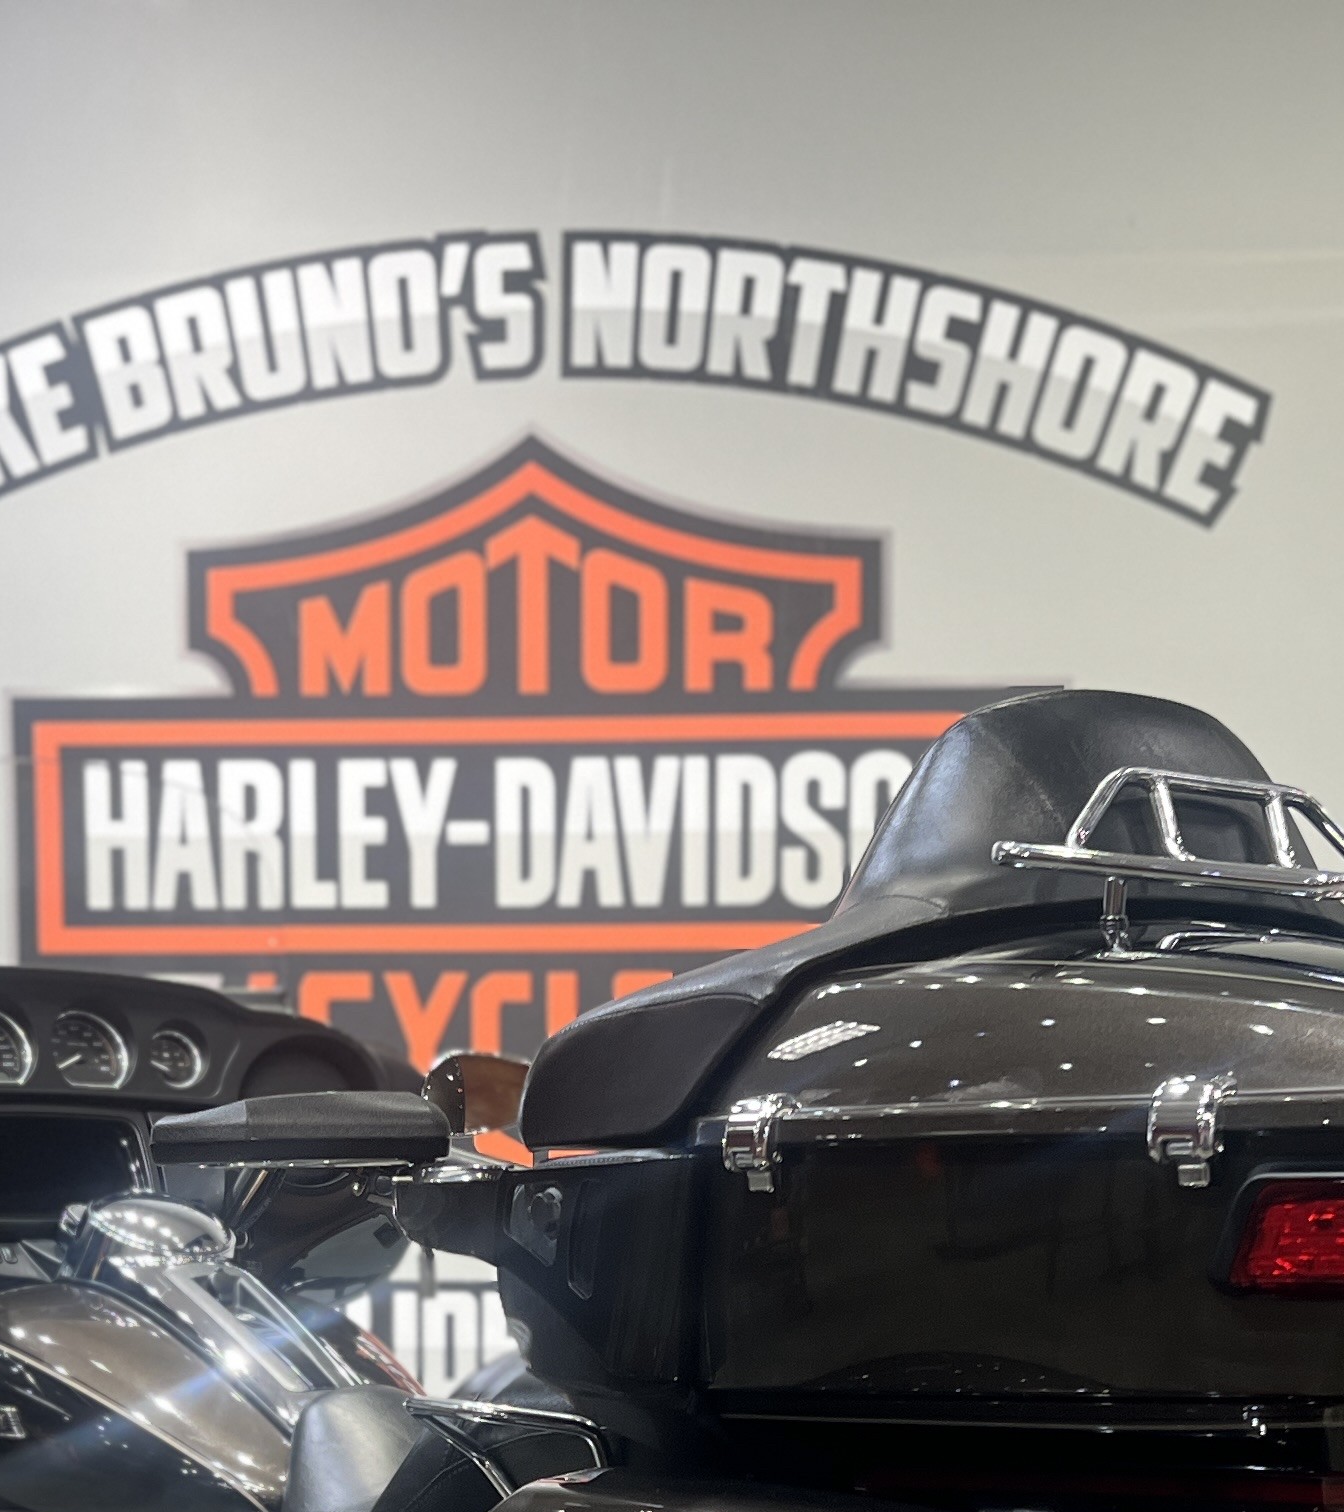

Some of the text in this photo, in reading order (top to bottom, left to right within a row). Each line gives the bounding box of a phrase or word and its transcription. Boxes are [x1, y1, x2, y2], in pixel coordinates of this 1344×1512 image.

[82, 240, 535, 442] BRUNO'S
[569, 240, 1260, 517] NORTHSHORE
[298, 514, 774, 697] MOTOR
[81, 748, 914, 914] HARLEY-DAVIDSO
